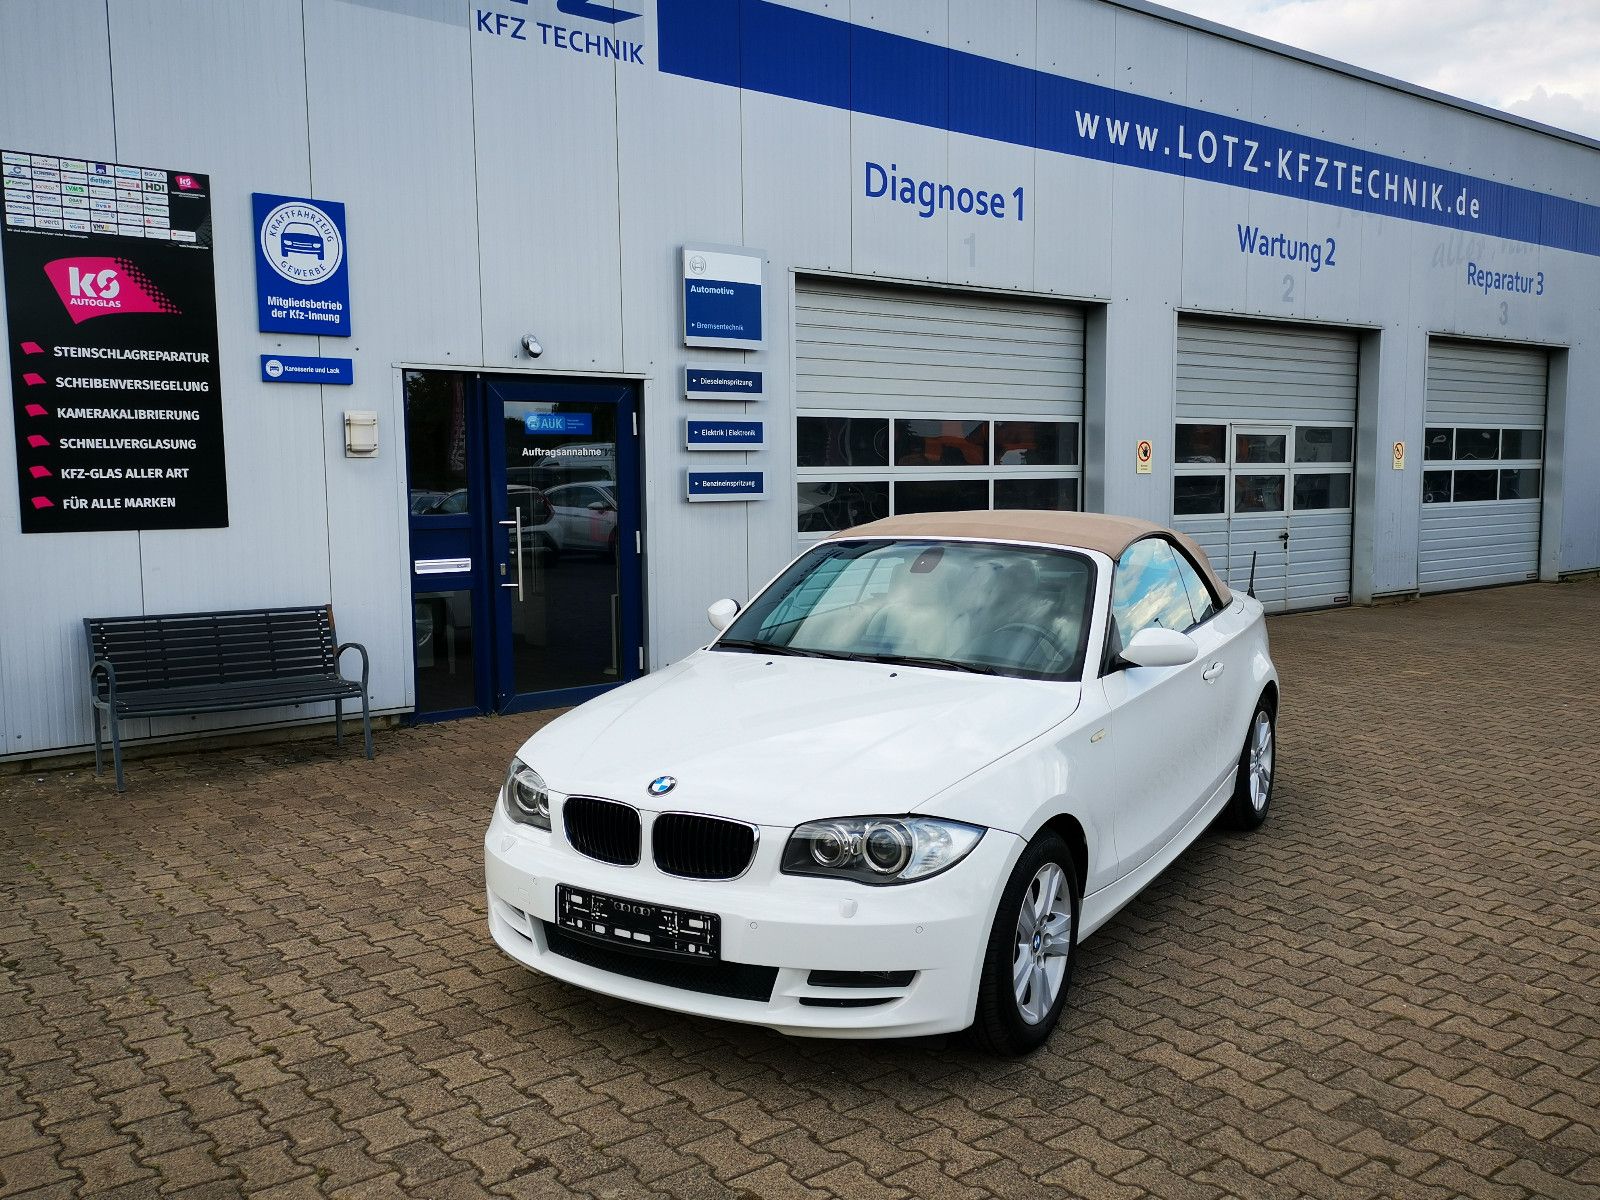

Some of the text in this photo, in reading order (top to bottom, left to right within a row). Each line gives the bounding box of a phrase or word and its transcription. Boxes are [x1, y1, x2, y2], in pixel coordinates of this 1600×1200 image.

[477, 9, 526, 41] KFZ
[537, 22, 644, 65] TECHNIK
[1075, 110, 1480, 219] www.LOTZ-KFZTECHNIK.de
[146, 183, 165, 192] HDI
[865, 161, 1024, 221] Diagnose 1
[269, 209, 334, 243] KRAFTFAHRZEUG
[1237, 223, 1336, 272] Wartung 2
[280, 260, 327, 278] GEWERBE
[1467, 261, 1545, 295] Reparatur 3
[690, 285, 735, 295] Automotive
[70, 297, 122, 308] AUTOGLAS
[267, 295, 342, 311] Mitgliedsbetrieb
[271, 308, 340, 324] der Kfz-Innung
[696, 321, 744, 331] Bremsentechnik
[53, 346, 210, 363] STEINSCHLAGREPARATUR
[284, 365, 314, 373] Karosserie
[315, 366, 326, 374] und
[55, 377, 209, 392] SCHEIBENVERSIEGELUNG
[700, 377, 753, 387] Dieseleinspritzung
[57, 407, 200, 421] KAMERAKALIBRIERUNG
[59, 438, 197, 450] SCHNELLVERGLASUNG
[522, 447, 602, 458] Auftragsannahme
[61, 468, 189, 479] KFZ-GLAS ALLER ART
[702, 480, 756, 488] Benzineinspritzung
[63, 496, 176, 509] FÜR ALLE MARKEN
